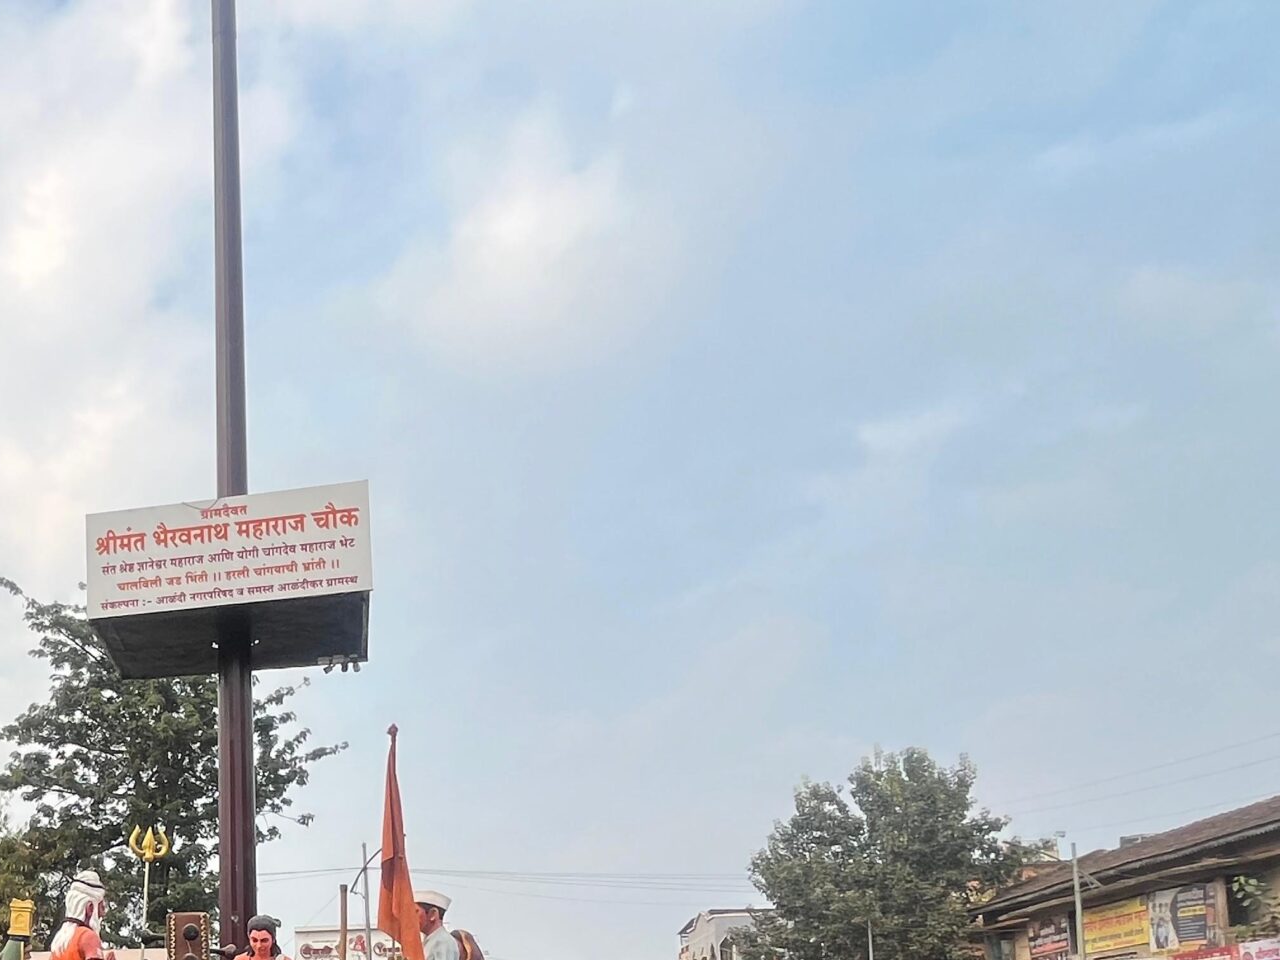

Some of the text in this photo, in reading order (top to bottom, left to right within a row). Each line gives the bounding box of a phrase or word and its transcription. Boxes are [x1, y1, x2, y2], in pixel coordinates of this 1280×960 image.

[96, 502, 360, 556] श्रीमंत भैरवनाथ महाराज चौक
[200, 503, 248, 520] ग्रामदैवत
[101, 560, 117, 576] संत
[170, 555, 204, 568] महाराज
[208, 549, 234, 563] आणि
[237, 545, 259, 561] योगी
[262, 542, 297, 557] चांगदेव
[299, 540, 336, 554] महाराज
[339, 535, 356, 549] भेट
[117, 575, 162, 592] चालविली
[166, 576, 182, 587] जड
[185, 569, 208, 584] भिंती
[225, 565, 250, 581] हरली
[302, 556, 327, 572] भ्रांती
[156, 591, 186, 605] आळंदी
[189, 586, 234, 601] नगरपरिषद
[236, 586, 244, 596] व
[247, 583, 274, 596] समस्त
[277, 577, 324, 592] आळंदीकर
[326, 574, 359, 588] ग्रामस्थ
